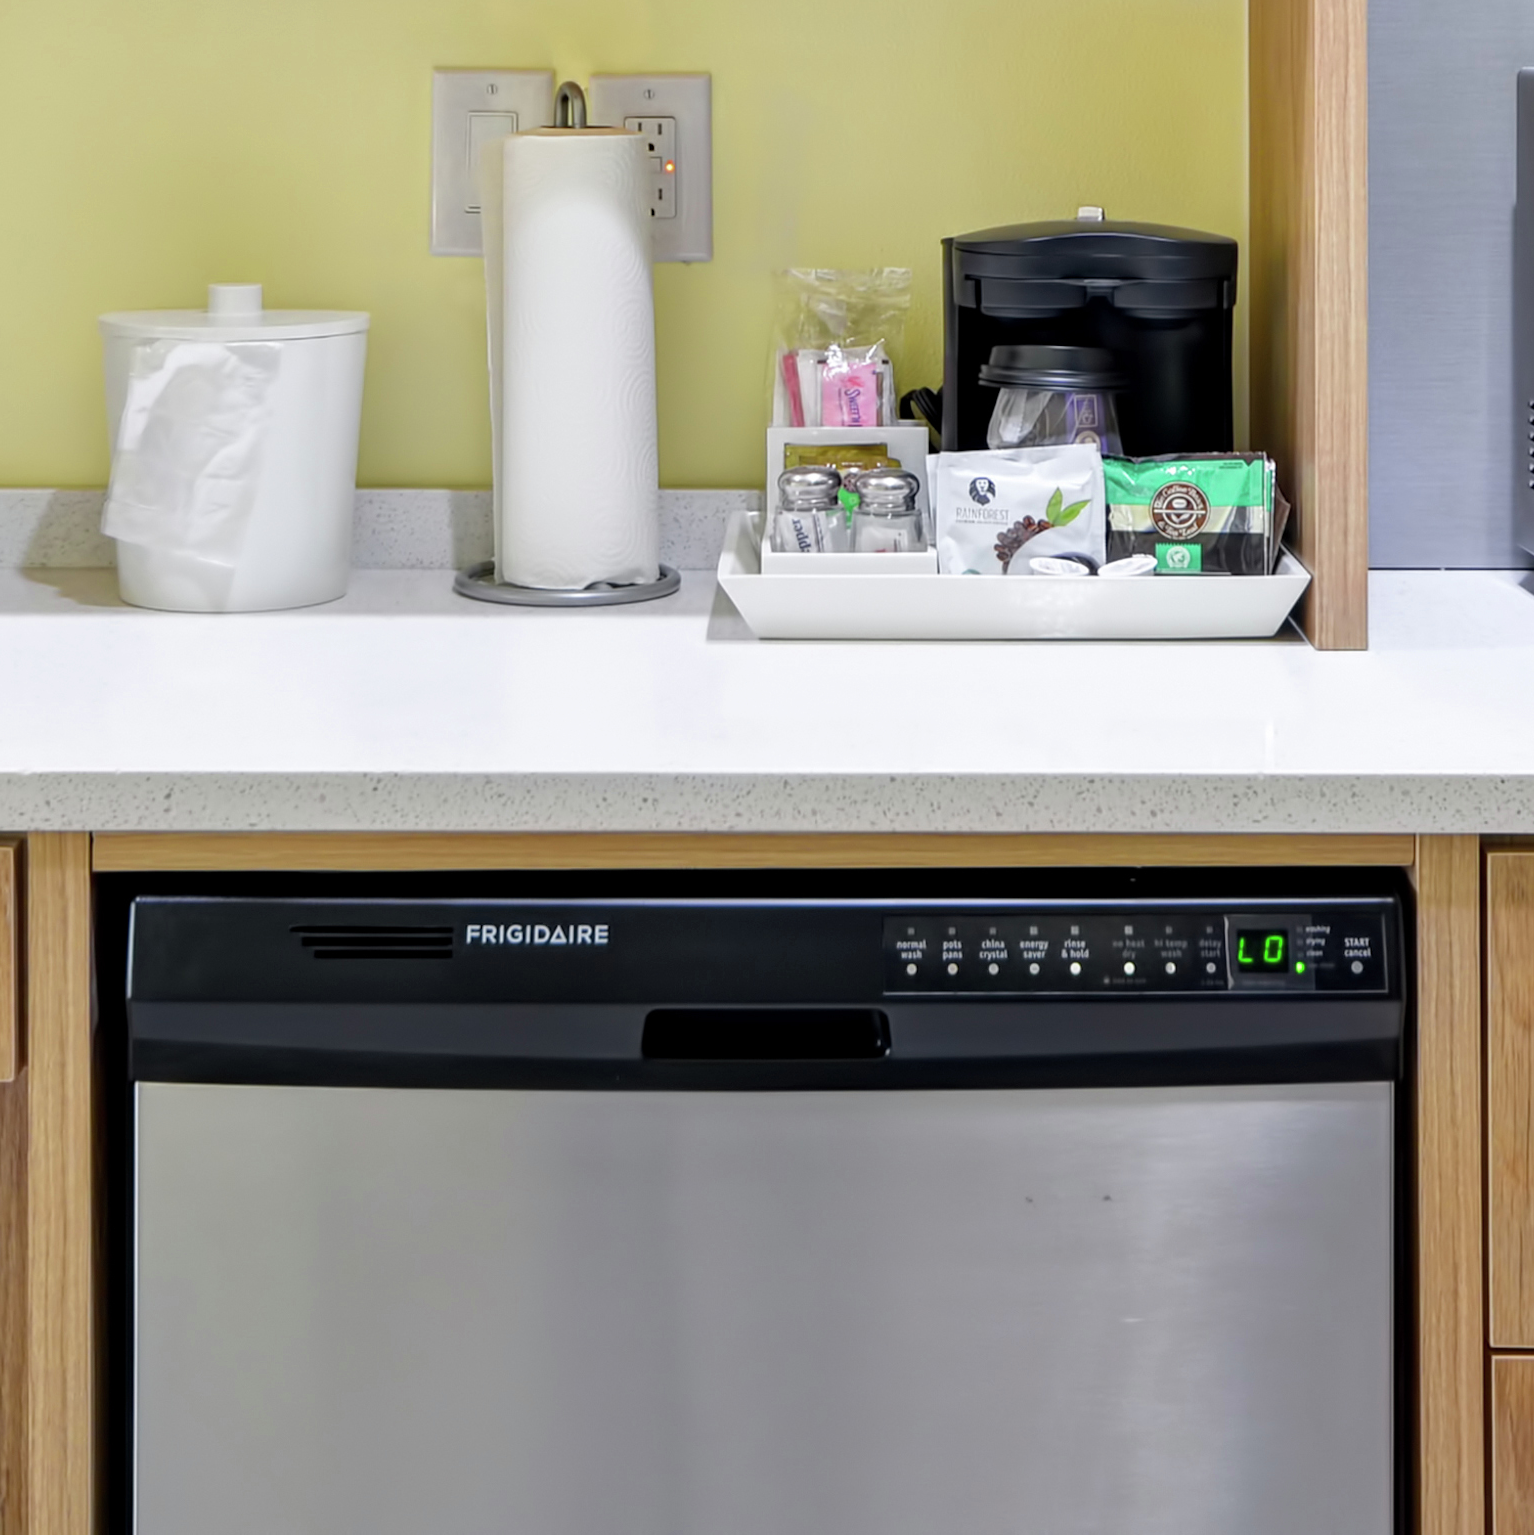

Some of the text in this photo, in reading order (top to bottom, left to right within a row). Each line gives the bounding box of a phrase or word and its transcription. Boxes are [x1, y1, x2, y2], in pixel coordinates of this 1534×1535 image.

[955, 507, 1010, 521] RAINFOREST
[466, 924, 609, 945] FRIGIDAIRE
[896, 939, 927, 949] normal
[942, 940, 962, 950] pots
[981, 939, 1005, 949] china
[1019, 940, 1049, 951] energy
[1064, 939, 1086, 949] rinse
[1344, 937, 1370, 947] START
[901, 950, 922, 959] wash
[942, 951, 963, 961] pans
[979, 949, 1008, 960] crystal
[1023, 950, 1046, 959] saver
[1061, 949, 1089, 959] & hold
[1344, 947, 1372, 957] cancel
